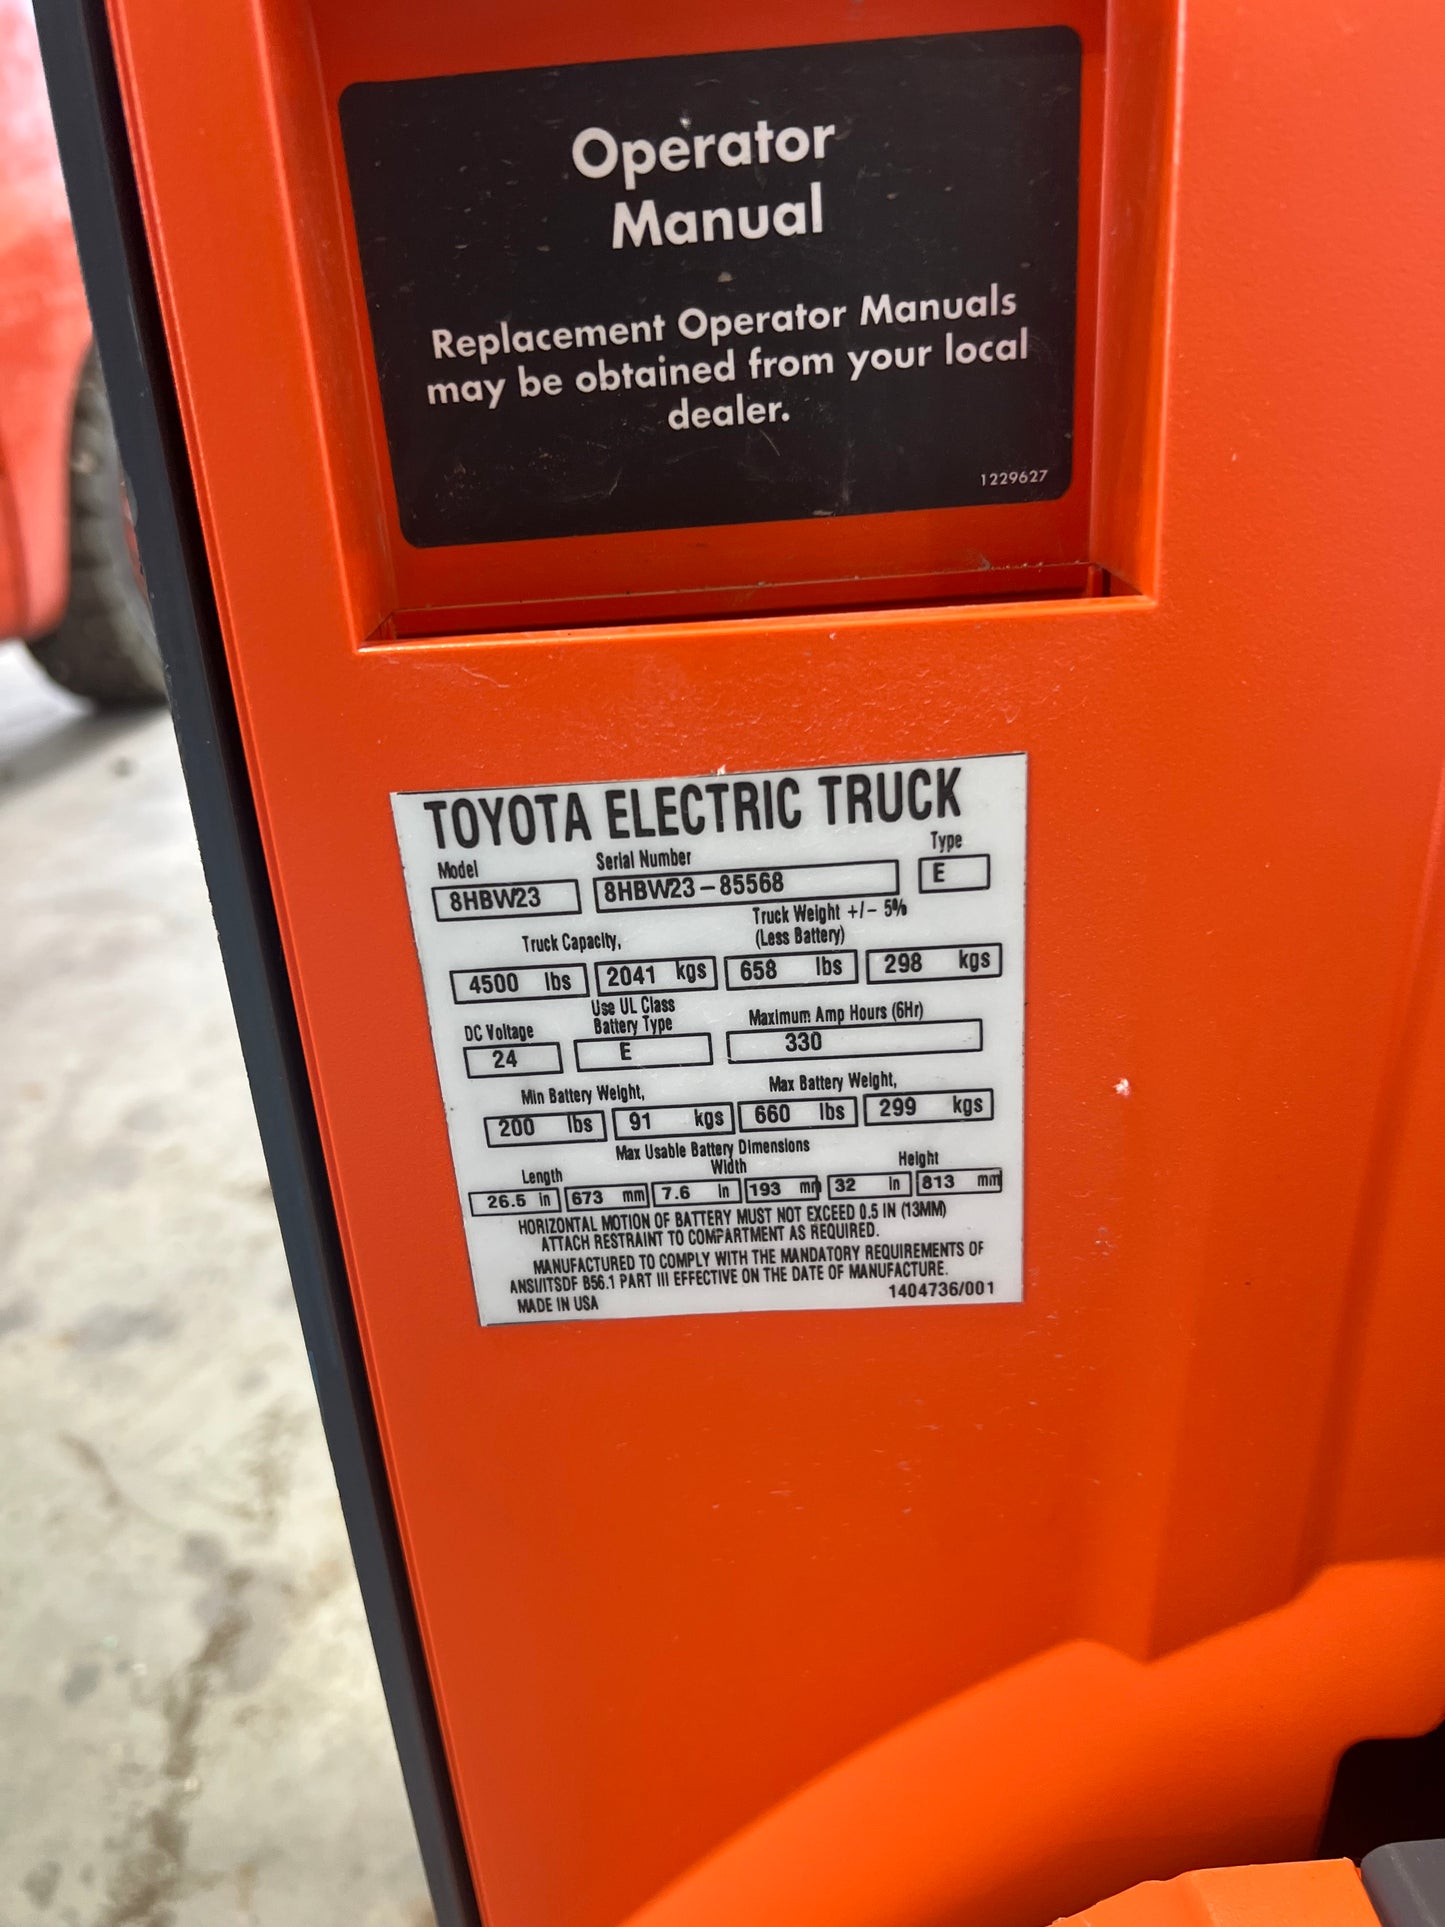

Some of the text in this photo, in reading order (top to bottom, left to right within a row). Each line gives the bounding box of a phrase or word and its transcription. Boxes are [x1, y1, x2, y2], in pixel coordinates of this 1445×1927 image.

[572, 122, 835, 189] Operator
[612, 182, 824, 249] Manual
[432, 283, 1017, 364] Replacement Operator Manuals
[427, 328, 1028, 409] may be obtained from your local
[668, 394, 790, 430] dealer.
[981, 470, 1048, 486] 1229627
[424, 767, 962, 849] TOYOTA ELECTRIC TRUCK
[930, 831, 962, 852] Type
[438, 860, 478, 879] Model
[596, 848, 692, 870] Serial Number
[932, 862, 945, 882] E
[450, 887, 541, 912] 8HBW23
[752, 906, 789, 925] Truck
[794, 904, 840, 924] Weight
[884, 899, 907, 917] 5%
[522, 932, 622, 953] Truck Capacity,
[755, 926, 845, 950] (Less Battery)
[740, 956, 842, 981] 658 lbs
[884, 949, 990, 973] 298 kgs
[469, 972, 571, 994] 4500 lbs
[607, 960, 707, 986] 2041 kgs
[591, 996, 675, 1016] Use UL Class
[749, 1001, 923, 1026] Maximum Amp Hours (6Hr)
[465, 1024, 534, 1042] DC Voltage
[594, 1015, 672, 1036] Battery Type
[620, 1042, 632, 1060] E
[785, 1032, 822, 1052] 330
[492, 1050, 518, 1068] 24
[769, 1071, 897, 1092] Max Battery Weight,
[521, 1084, 645, 1105] Min Battery Weight,
[755, 1103, 844, 1123] 660 lbs
[879, 1095, 983, 1117] 299 kgs
[498, 1115, 593, 1137] 200 lbs
[629, 1108, 724, 1130] 91 kgs
[616, 1138, 810, 1161] Max Usable Battery Dimensions
[898, 1151, 939, 1168] Height
[522, 1169, 563, 1186] Length
[711, 1159, 747, 1175] Width
[749, 1182, 781, 1196] 193
[835, 1178, 856, 1192] 32
[922, 1174, 1001, 1189] 813 mm
[488, 1193, 550, 1209] 26.5 in
[572, 1188, 645, 1205] 673 mm
[662, 1186, 690, 1200] 7.6
[519, 1201, 947, 1235] HORIZONTAL MOTION OF BATTERY MUST NOT EXCEED 0.5 IN (13MM)
[542, 1222, 881, 1252] ATTACH RESTRAINT TO COMPARTMENT AS REQUIRED.
[533, 1241, 984, 1275] MANUFACTURED TO COMPLY WITH THE MANDATORY REQUIREMENTS OF
[510, 1260, 949, 1294] ANSI/ITSDF B56.1 PART III EFFECTIVE ON THE DATE OF MANUFACTURE.
[888, 1281, 994, 1299] 1404736/001
[518, 1295, 598, 1314] MADE IN USA
